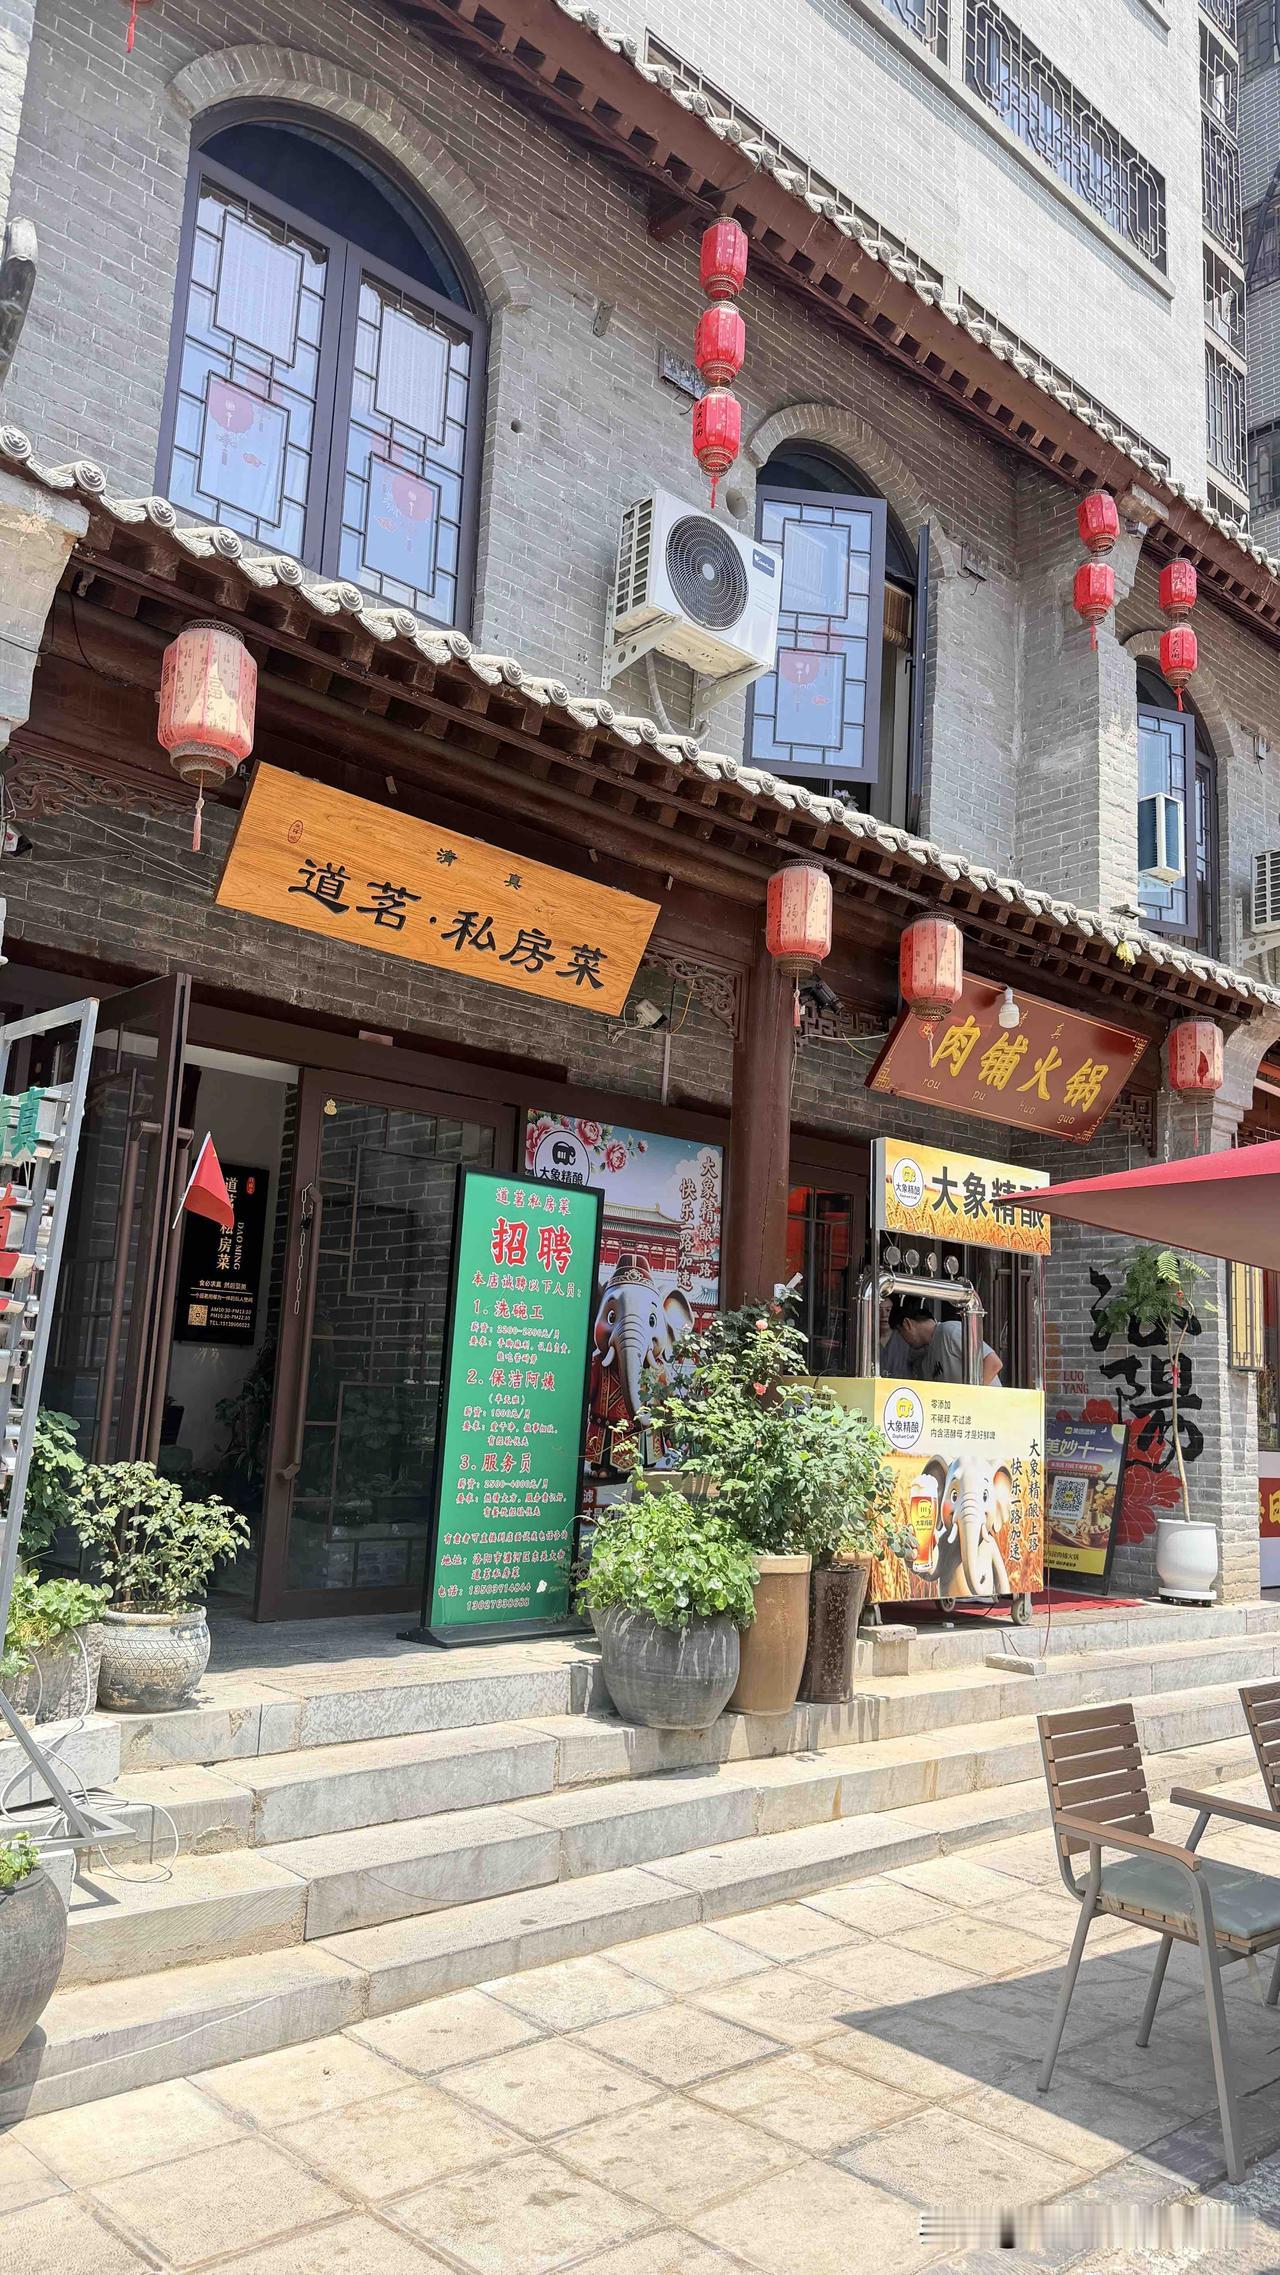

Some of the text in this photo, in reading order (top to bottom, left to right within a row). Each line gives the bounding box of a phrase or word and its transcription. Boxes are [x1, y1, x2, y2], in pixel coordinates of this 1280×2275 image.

[287, 858, 608, 990] 道茗·私房菜
[930, 1014, 1109, 1113] 肉铺火锅
[921, 1077, 1076, 1126] rou pu huo guo
[496, 1187, 571, 1215] 道茗私房菜
[539, 1166, 584, 1186] 大象精酿
[676, 1178, 697, 1293] 快乐一路加速
[699, 1156, 719, 1280] 大象精酿上路
[491, 1216, 572, 1274] 招聘
[1063, 1371, 1084, 1381] LUO
[1063, 1383, 1089, 1394] YANG
[887, 1420, 919, 1433] 大象精酿
[1046, 1438, 1113, 1459] 美妙十一
[1008, 1457, 1023, 1562] 快乐一路加速
[1027, 1439, 1041, 1553] 大象精酿上路
